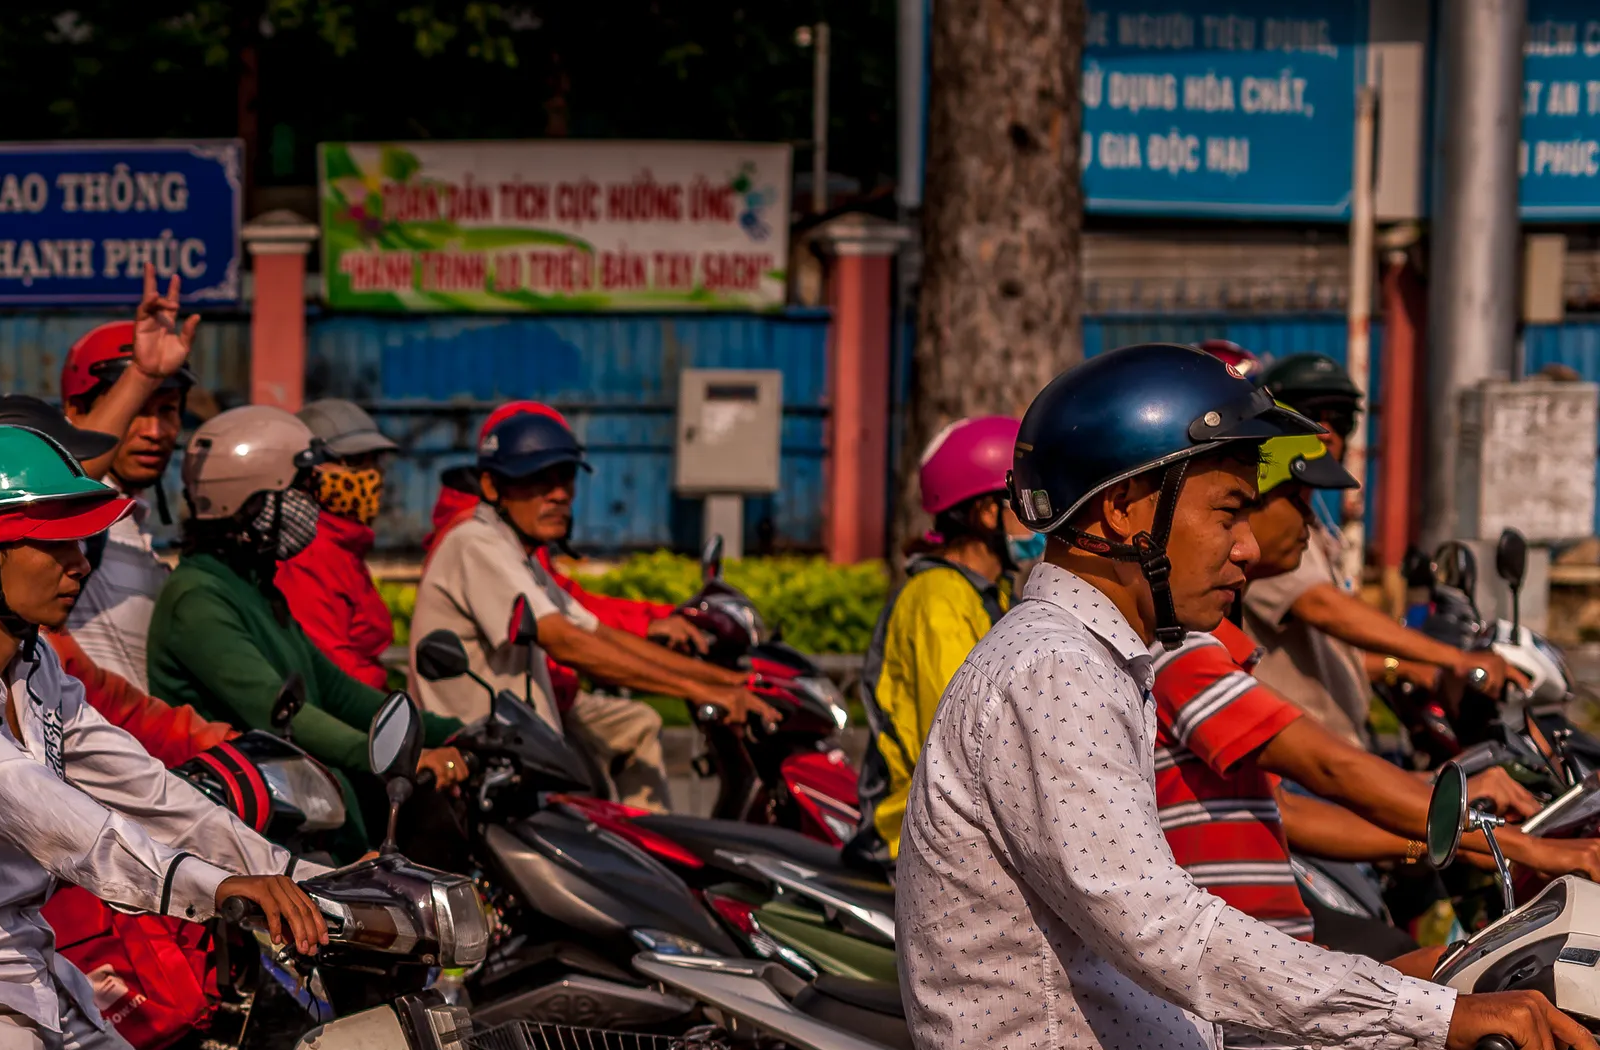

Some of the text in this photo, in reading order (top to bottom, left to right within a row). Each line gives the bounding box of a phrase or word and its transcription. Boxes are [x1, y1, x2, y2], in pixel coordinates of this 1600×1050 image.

[1108, 72, 1178, 116] DỤNG
[1099, 131, 1142, 170] GIA
[57, 163, 189, 213] THÔNG
[102, 229, 207, 281] PHÚC
